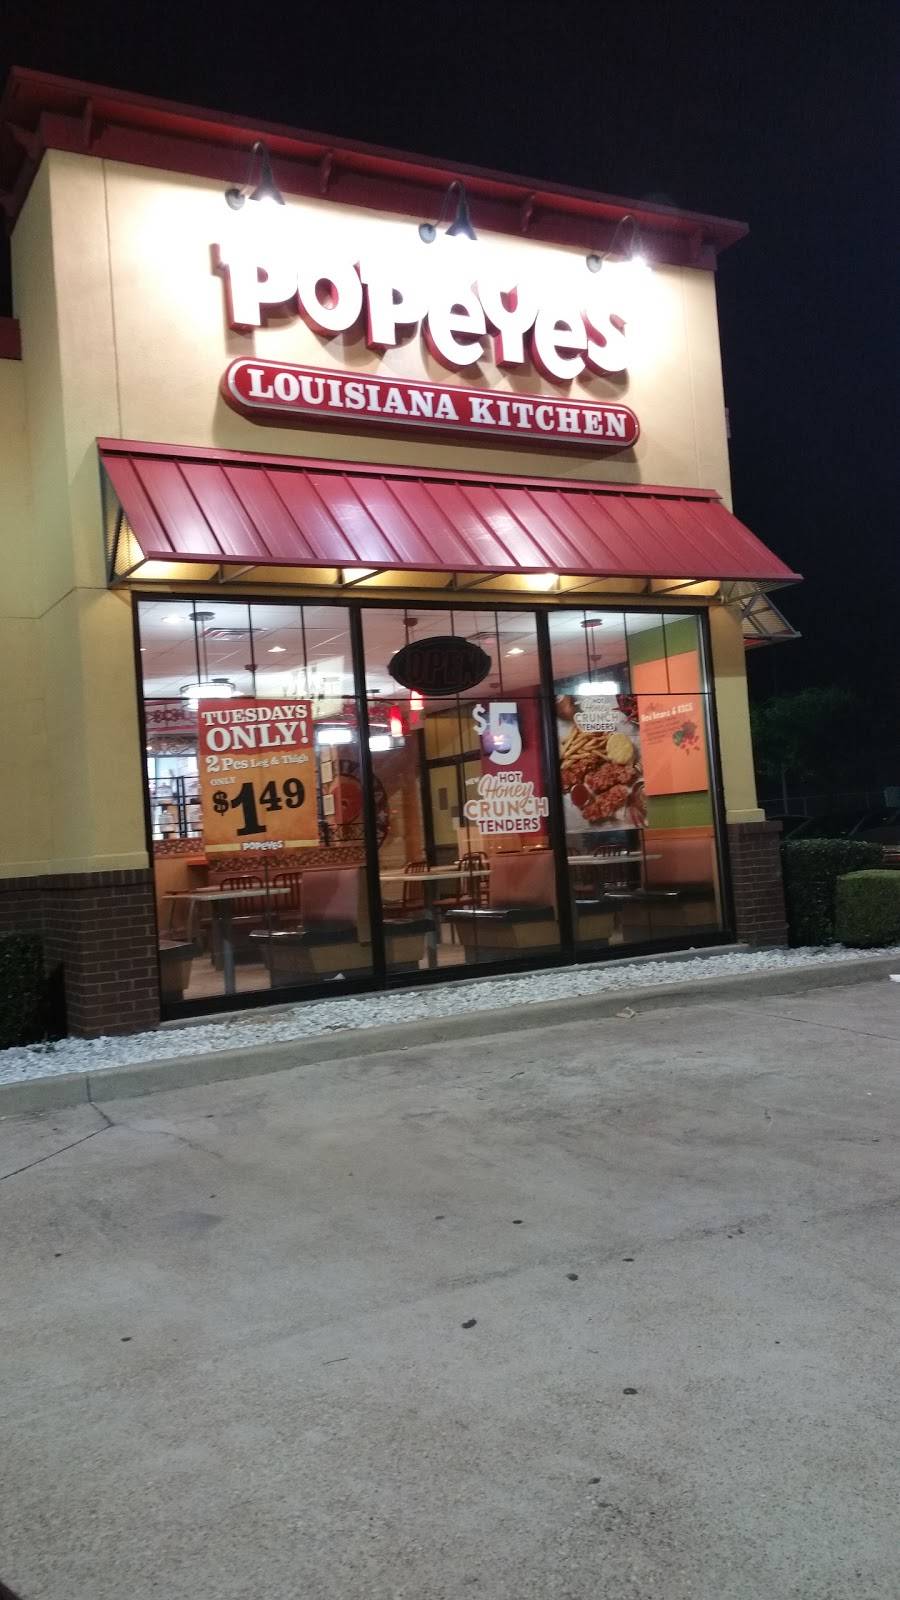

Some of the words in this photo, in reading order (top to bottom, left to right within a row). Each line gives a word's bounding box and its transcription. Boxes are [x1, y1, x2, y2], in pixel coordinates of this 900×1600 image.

[247, 368, 460, 421] LOUISIANA
[469, 396, 628, 438] KITCHEN
[202, 706, 307, 724] TUESDAYS
[206, 722, 309, 752] ONLY!
[206, 755, 220, 773] 2
[221, 757, 249, 771] Pcs
[210, 776, 237, 786] ONLY
[499, 773, 521, 783] HOT
[480, 776, 533, 808] Honey
[466, 797, 548, 818] CRUNCH
[478, 817, 539, 833] TENDERS
